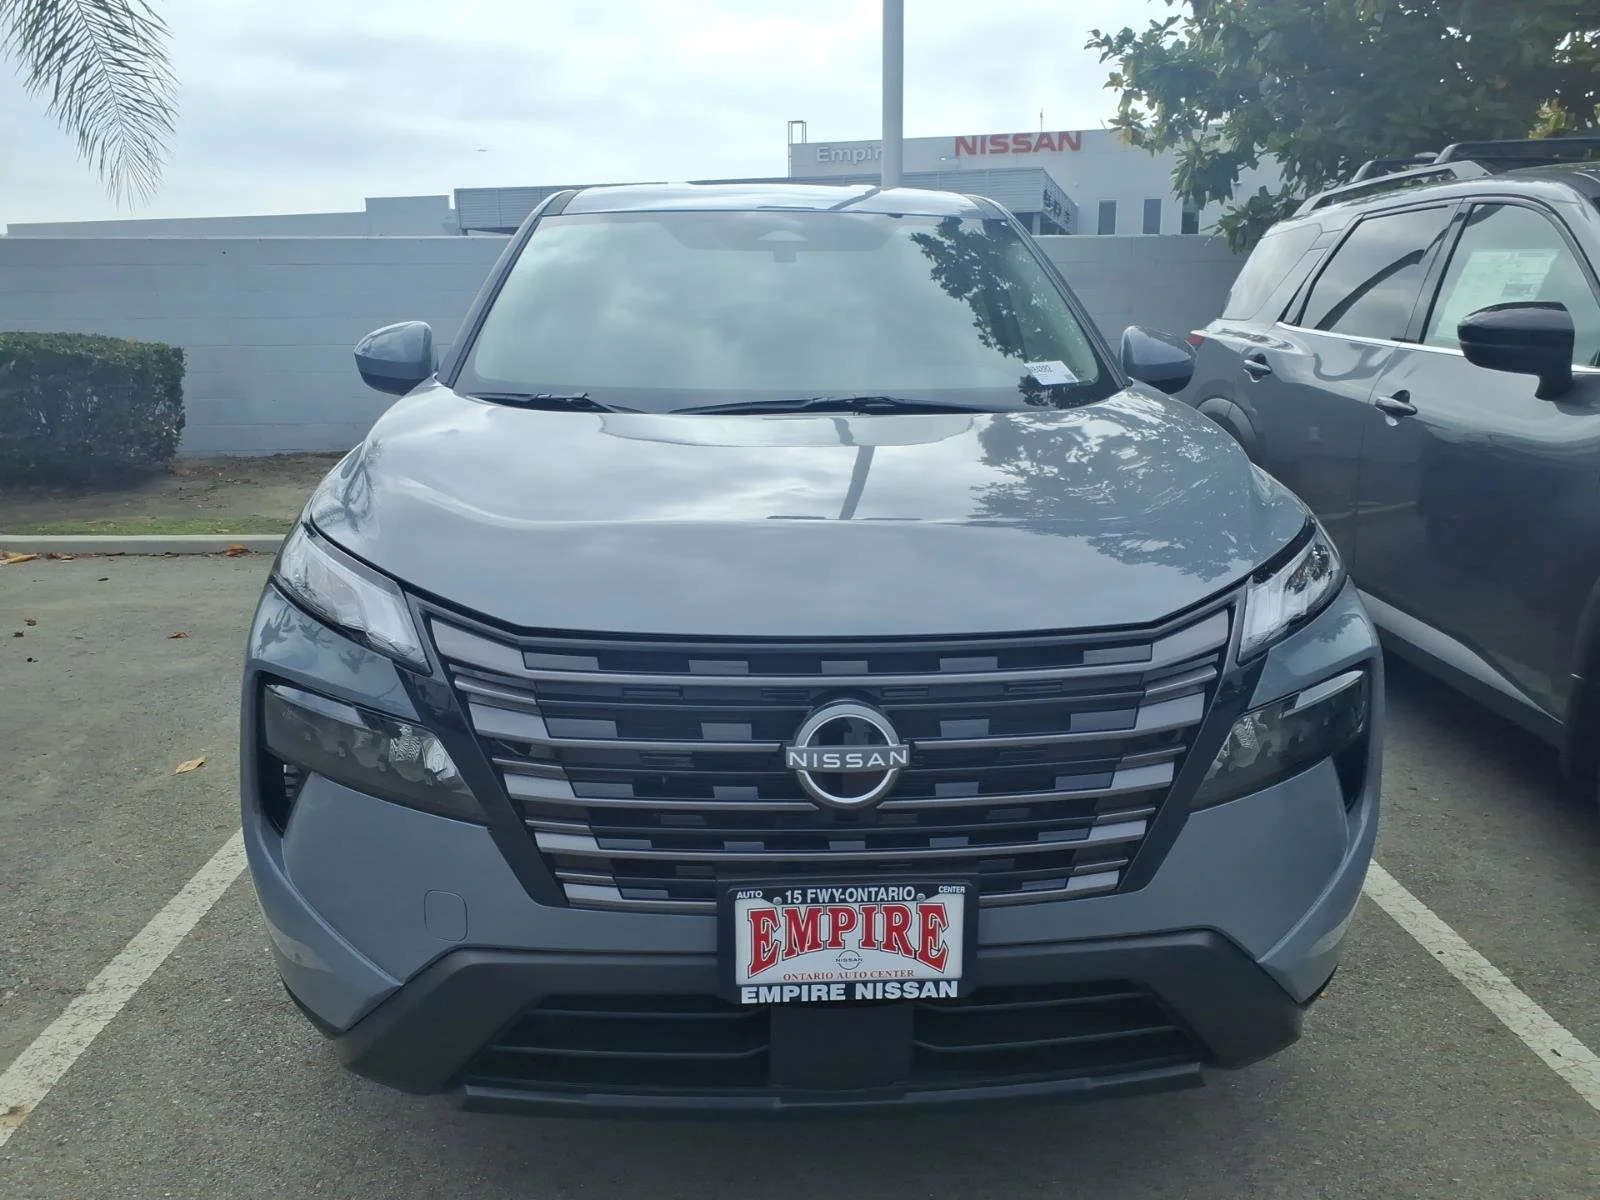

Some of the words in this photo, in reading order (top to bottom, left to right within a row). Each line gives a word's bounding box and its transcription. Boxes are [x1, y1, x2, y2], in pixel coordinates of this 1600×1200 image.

[954, 131, 1082, 156] NISSAN
[816, 144, 883, 165] Empir
[789, 749, 908, 768] NISSAN
[736, 890, 763, 899] AUTO
[785, 890, 802, 904] 15
[806, 886, 915, 903] FWY-ONTARIO
[938, 885, 966, 894] CENTER
[747, 903, 949, 979] EMPIRE
[783, 972, 833, 981] ONTARIO
[837, 971, 867, 980] AUTO
[871, 969, 914, 979] CENTER
[741, 984, 845, 1004] EMPIRE
[855, 981, 958, 1000] NISSAN
